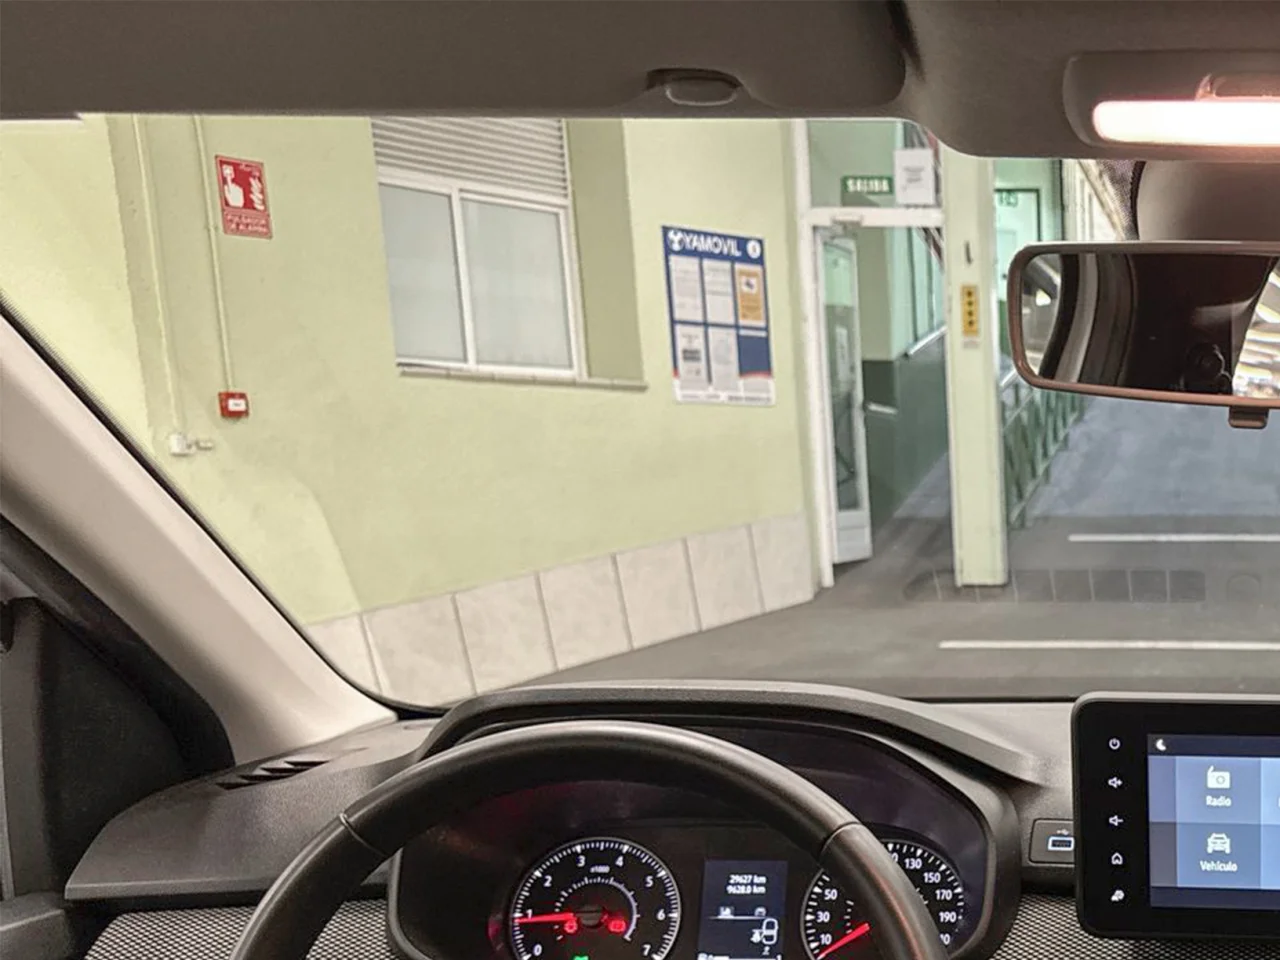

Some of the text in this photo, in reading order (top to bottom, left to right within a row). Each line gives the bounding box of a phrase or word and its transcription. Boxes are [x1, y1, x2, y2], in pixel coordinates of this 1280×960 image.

[684, 231, 742, 257] YAMOVIL
[1206, 796, 1232, 807] Radio
[577, 856, 586, 867] 3
[615, 856, 624, 867] 4
[904, 858, 923, 869] 130
[1200, 860, 1238, 872] Vehículo
[544, 876, 552, 887] 2
[645, 876, 654, 887] 5
[753, 875, 767, 884] km
[923, 872, 941, 884] 150
[752, 885, 766, 894] km
[824, 889, 838, 900] 50
[935, 889, 953, 901] 170
[657, 909, 665, 921] 6
[817, 911, 830, 922] 30
[939, 911, 956, 923] 190
[820, 934, 832, 945] 10
[533, 944, 542, 956] 0
[643, 944, 651, 956] 7
